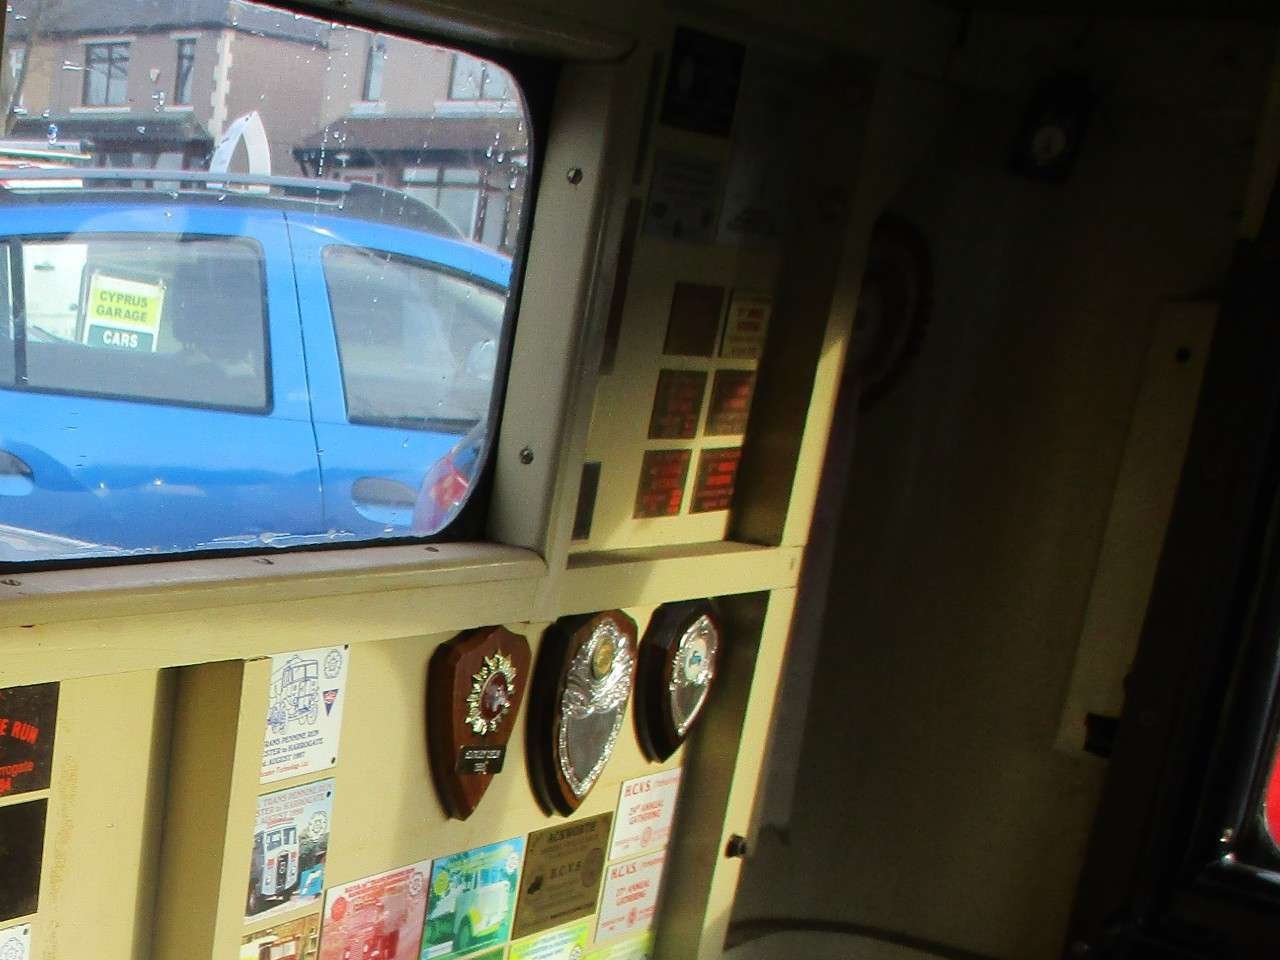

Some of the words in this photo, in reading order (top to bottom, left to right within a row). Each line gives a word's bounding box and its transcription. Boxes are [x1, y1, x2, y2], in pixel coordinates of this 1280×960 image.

[99, 290, 148, 308] CYPRUS
[96, 304, 148, 322] GARAGE
[103, 330, 138, 348] CARS
[11, 721, 39, 744] RUN
